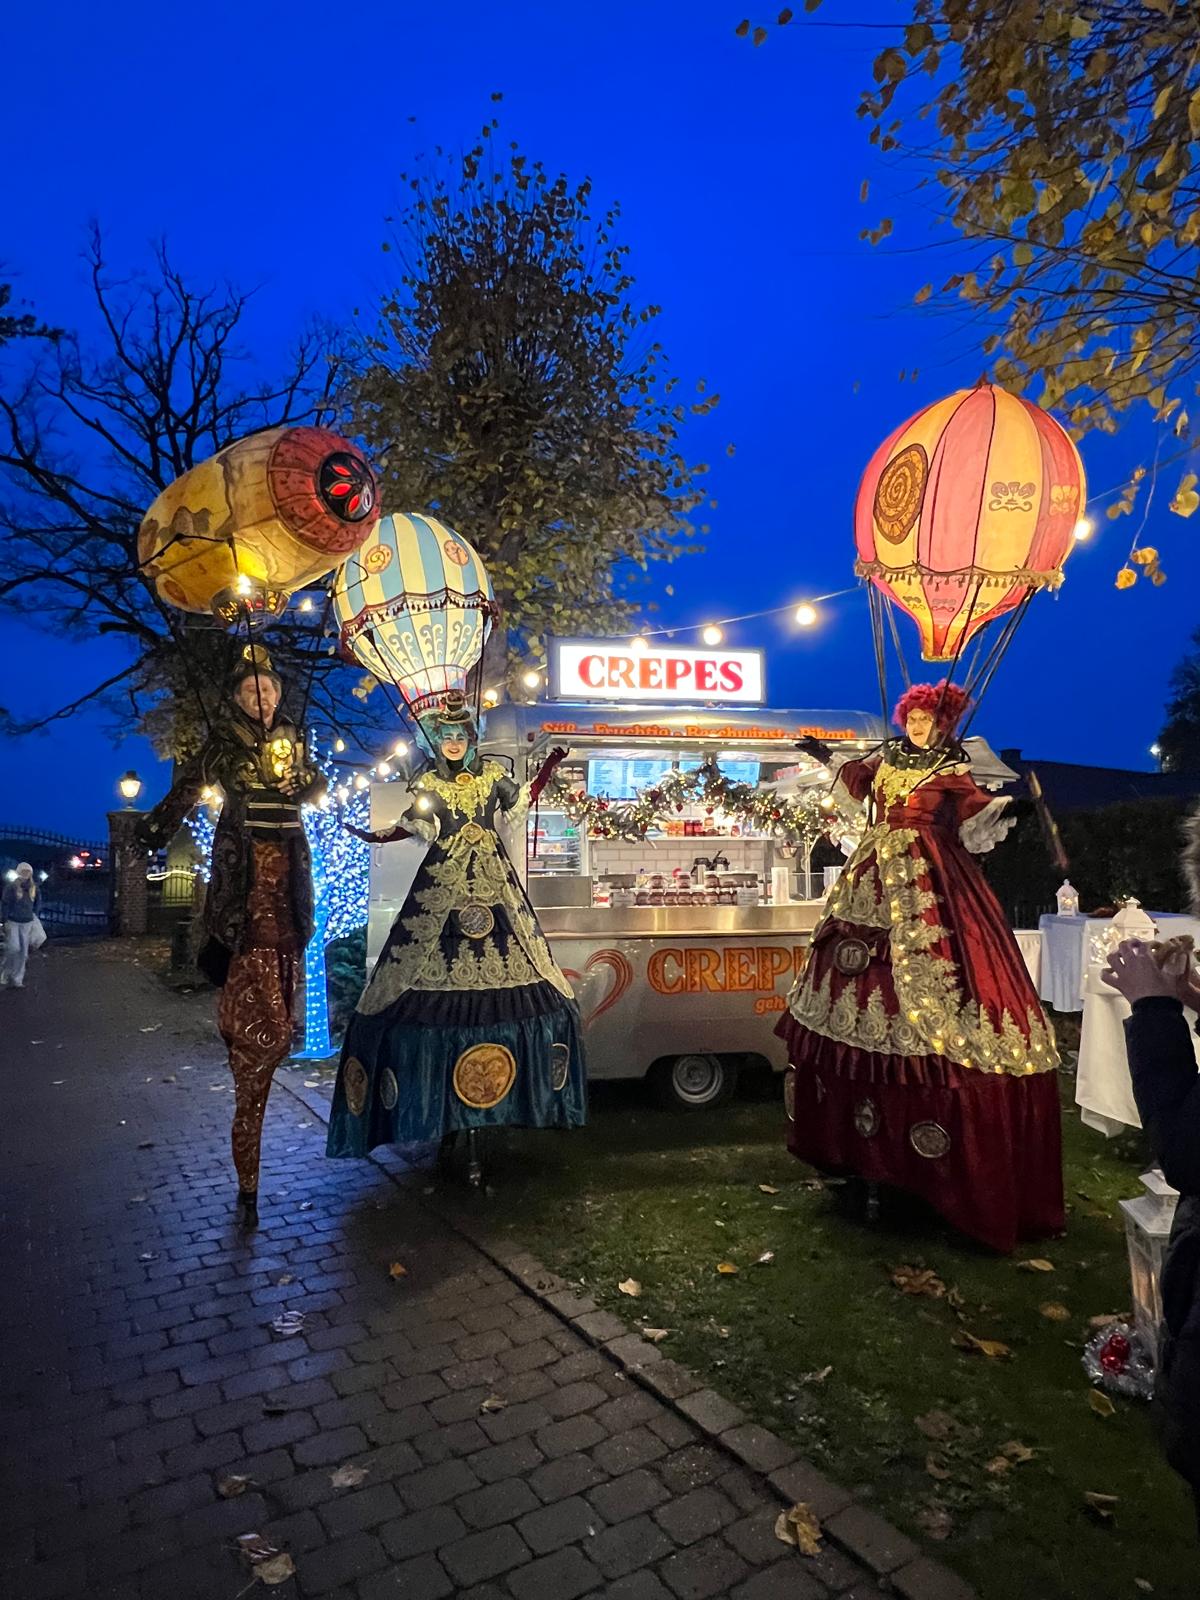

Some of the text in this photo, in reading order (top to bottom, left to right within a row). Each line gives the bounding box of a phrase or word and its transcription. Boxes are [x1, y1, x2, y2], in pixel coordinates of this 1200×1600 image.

[577, 654, 744, 693] CREPES
[593, 723, 671, 736] Fruchtig
[647, 946, 808, 995] CREP
